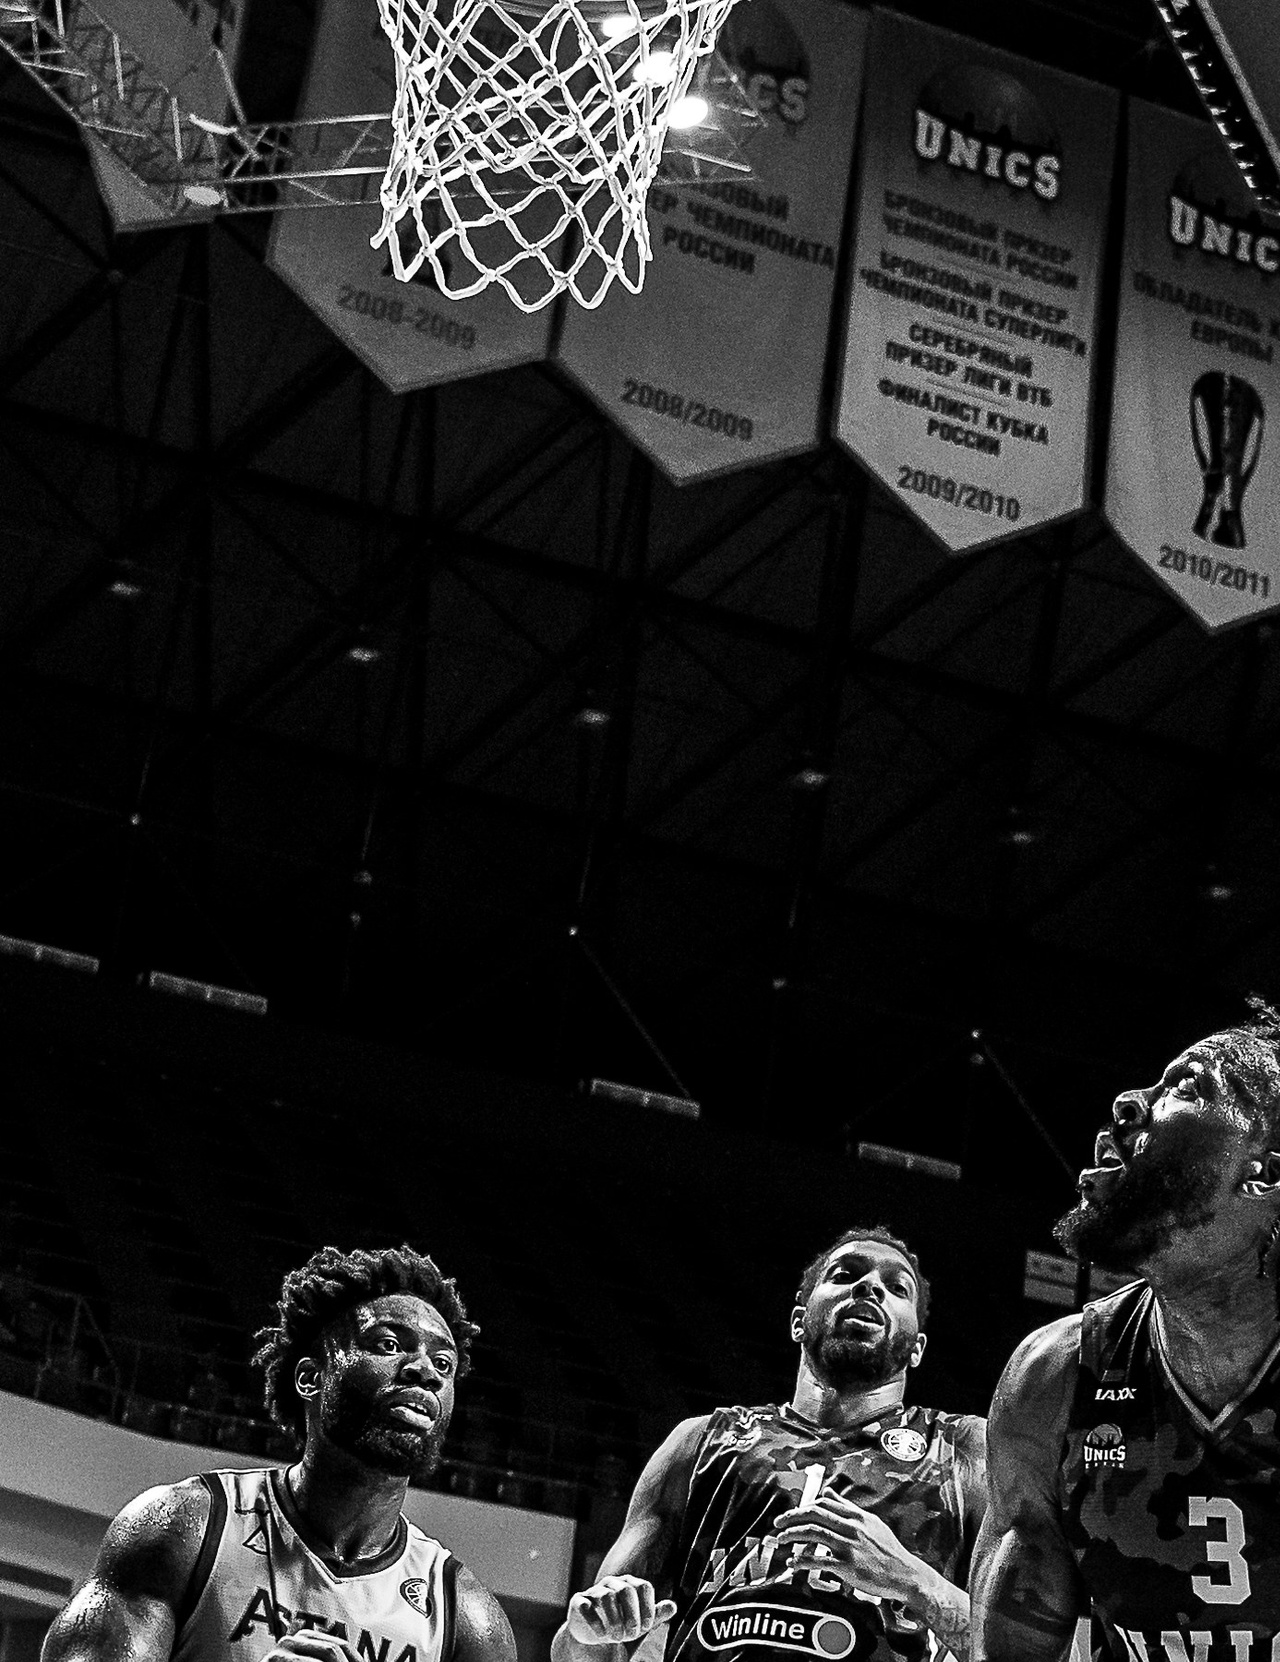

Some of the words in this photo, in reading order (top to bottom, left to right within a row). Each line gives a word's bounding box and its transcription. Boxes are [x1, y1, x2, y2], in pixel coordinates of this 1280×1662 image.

[914, 109, 1062, 200] UNICS
[876, 377, 982, 425] ФИНАЛИСТ
[885, 340, 958, 377] ПРИЗЕР
[963, 366, 1012, 398] ЛИГИ
[1015, 381, 1054, 408] ВТБ
[622, 380, 755, 443] 2008/2009
[898, 464, 1021, 522] 2009/2010
[1158, 544, 1271, 598] 2010/2011
[1083, 1444, 1127, 1462] UNICS
[1187, 1496, 1252, 1606] 3
[710, 1613, 805, 1641] Winline
